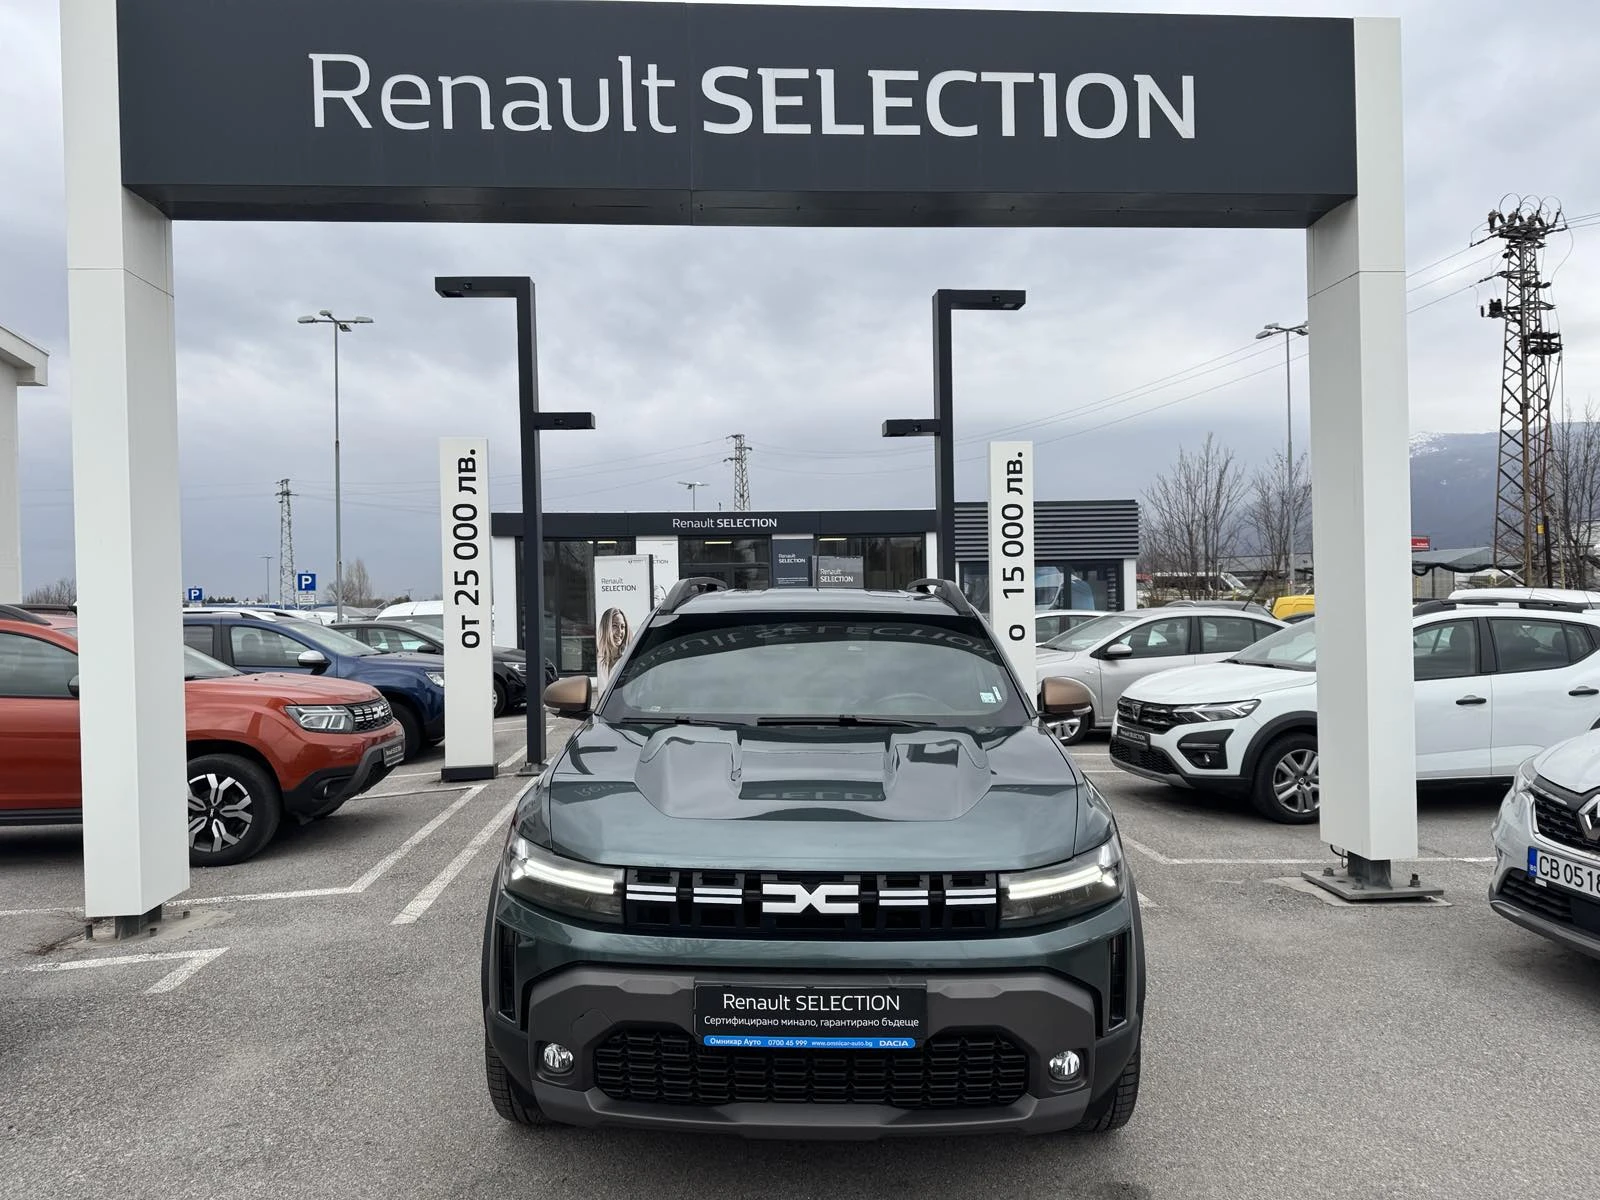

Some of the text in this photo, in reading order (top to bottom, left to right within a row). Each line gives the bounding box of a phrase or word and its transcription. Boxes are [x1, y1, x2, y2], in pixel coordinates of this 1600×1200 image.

[308, 53, 1195, 139] Renault SELECTION
[1006, 452, 1023, 495] лв.
[672, 518, 777, 528] Renault SELECTION
[1001, 503, 1024, 557] 000
[452, 449, 480, 648] от 25 000 лв.
[302, 576, 312, 589] P
[820, 575, 854, 583] SELECTION
[1002, 566, 1024, 599] 15
[191, 590, 199, 600] P
[1540, 856, 1560, 880] CB
[723, 993, 900, 1011] Renault SELECTION
[704, 1015, 919, 1028] Сертифицирано минало, гарантирано бъдеще
[710, 1037, 742, 1046] Омникар
[744, 1038, 761, 1047] Ауто
